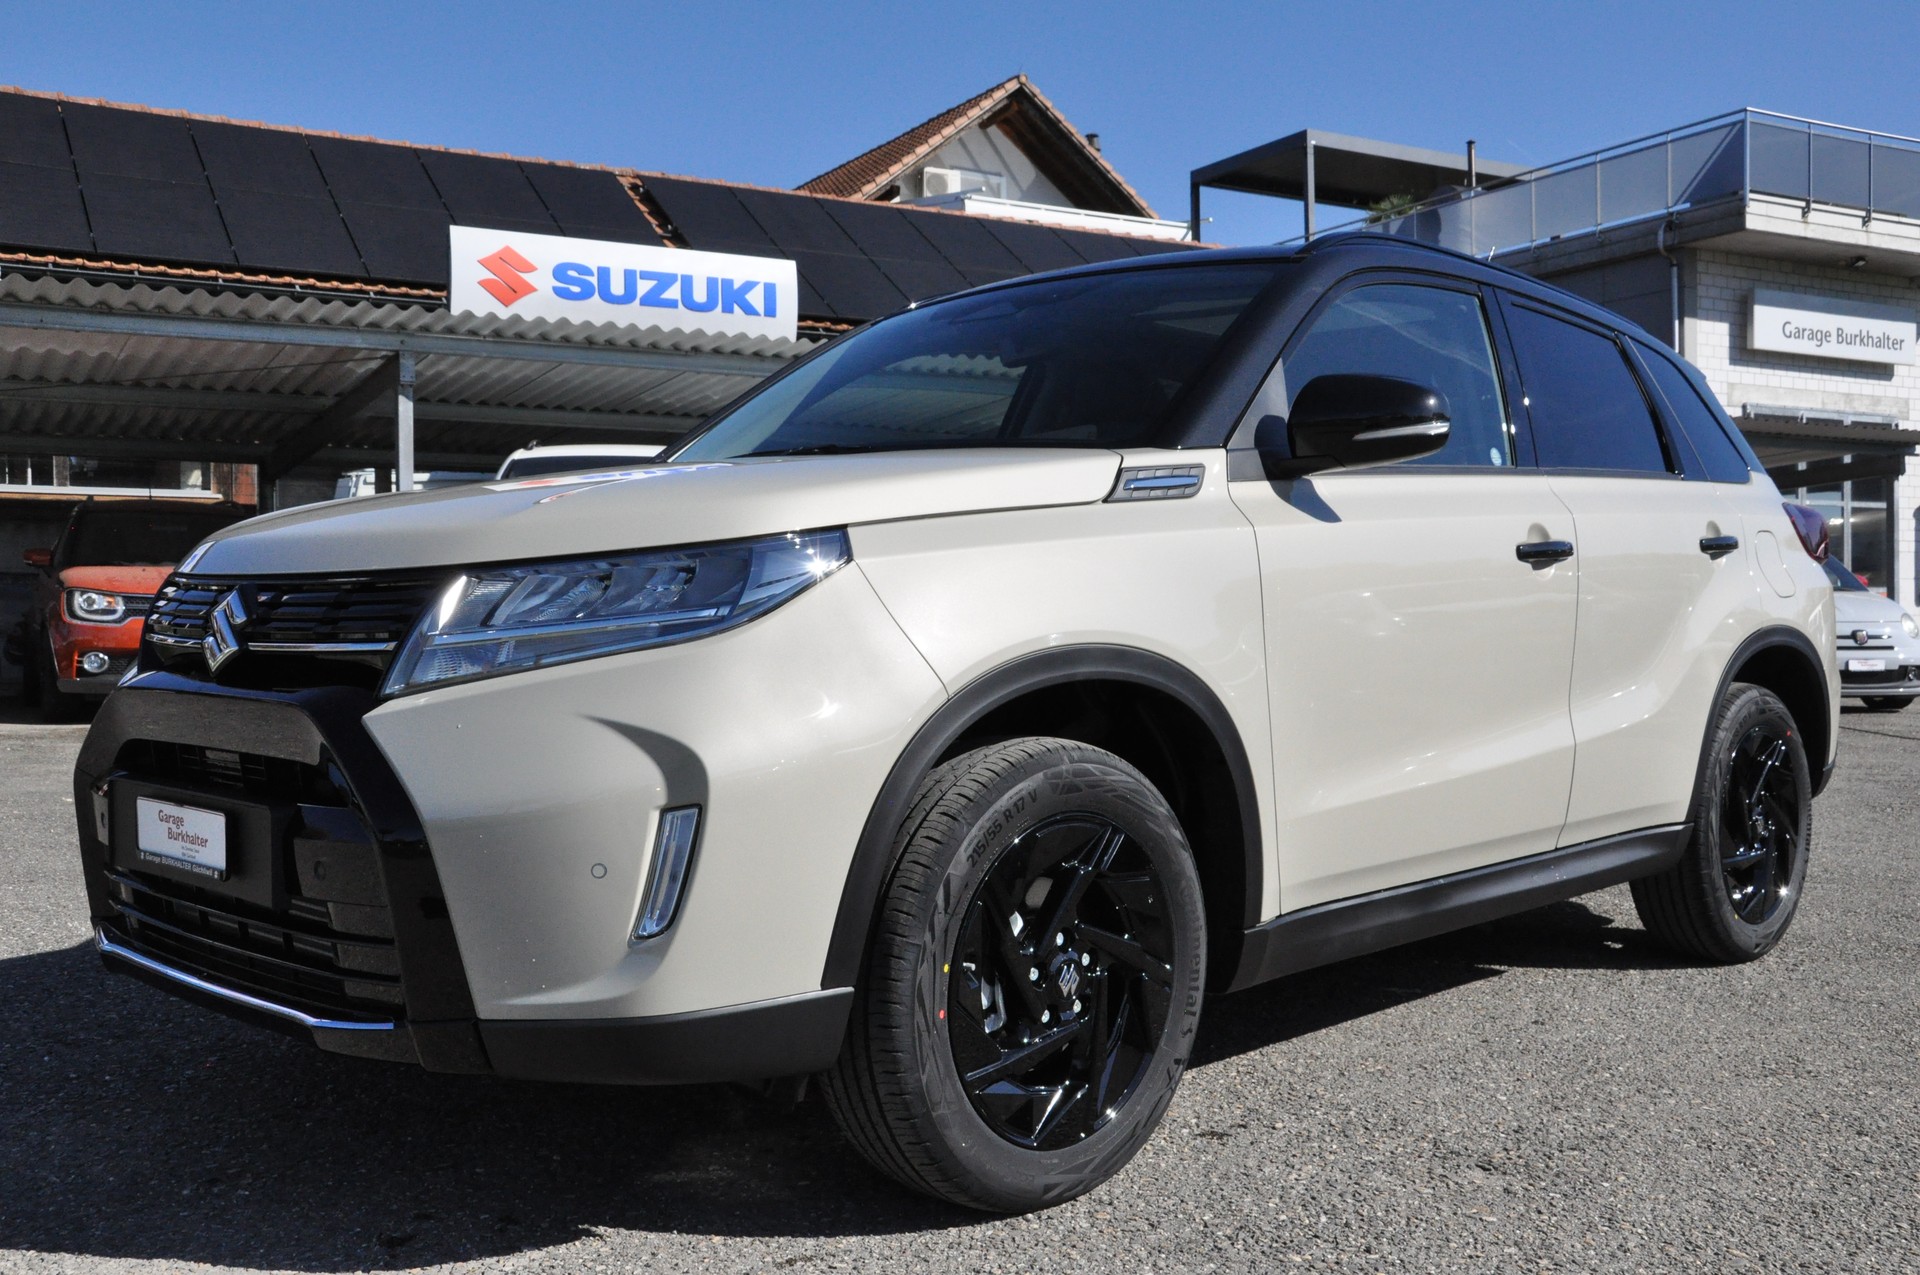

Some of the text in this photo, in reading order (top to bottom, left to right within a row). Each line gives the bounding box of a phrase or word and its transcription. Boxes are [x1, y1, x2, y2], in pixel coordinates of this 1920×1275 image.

[551, 261, 777, 318] SUZUKI
[1782, 321, 1905, 351] Garage Burkhalter
[158, 809, 185, 829] Garage
[966, 788, 1037, 868] 215/55 R 17 V
[167, 827, 209, 848] Burkhalter
[145, 853, 161, 864] Garage
[161, 857, 191, 869] BURKHALTER
